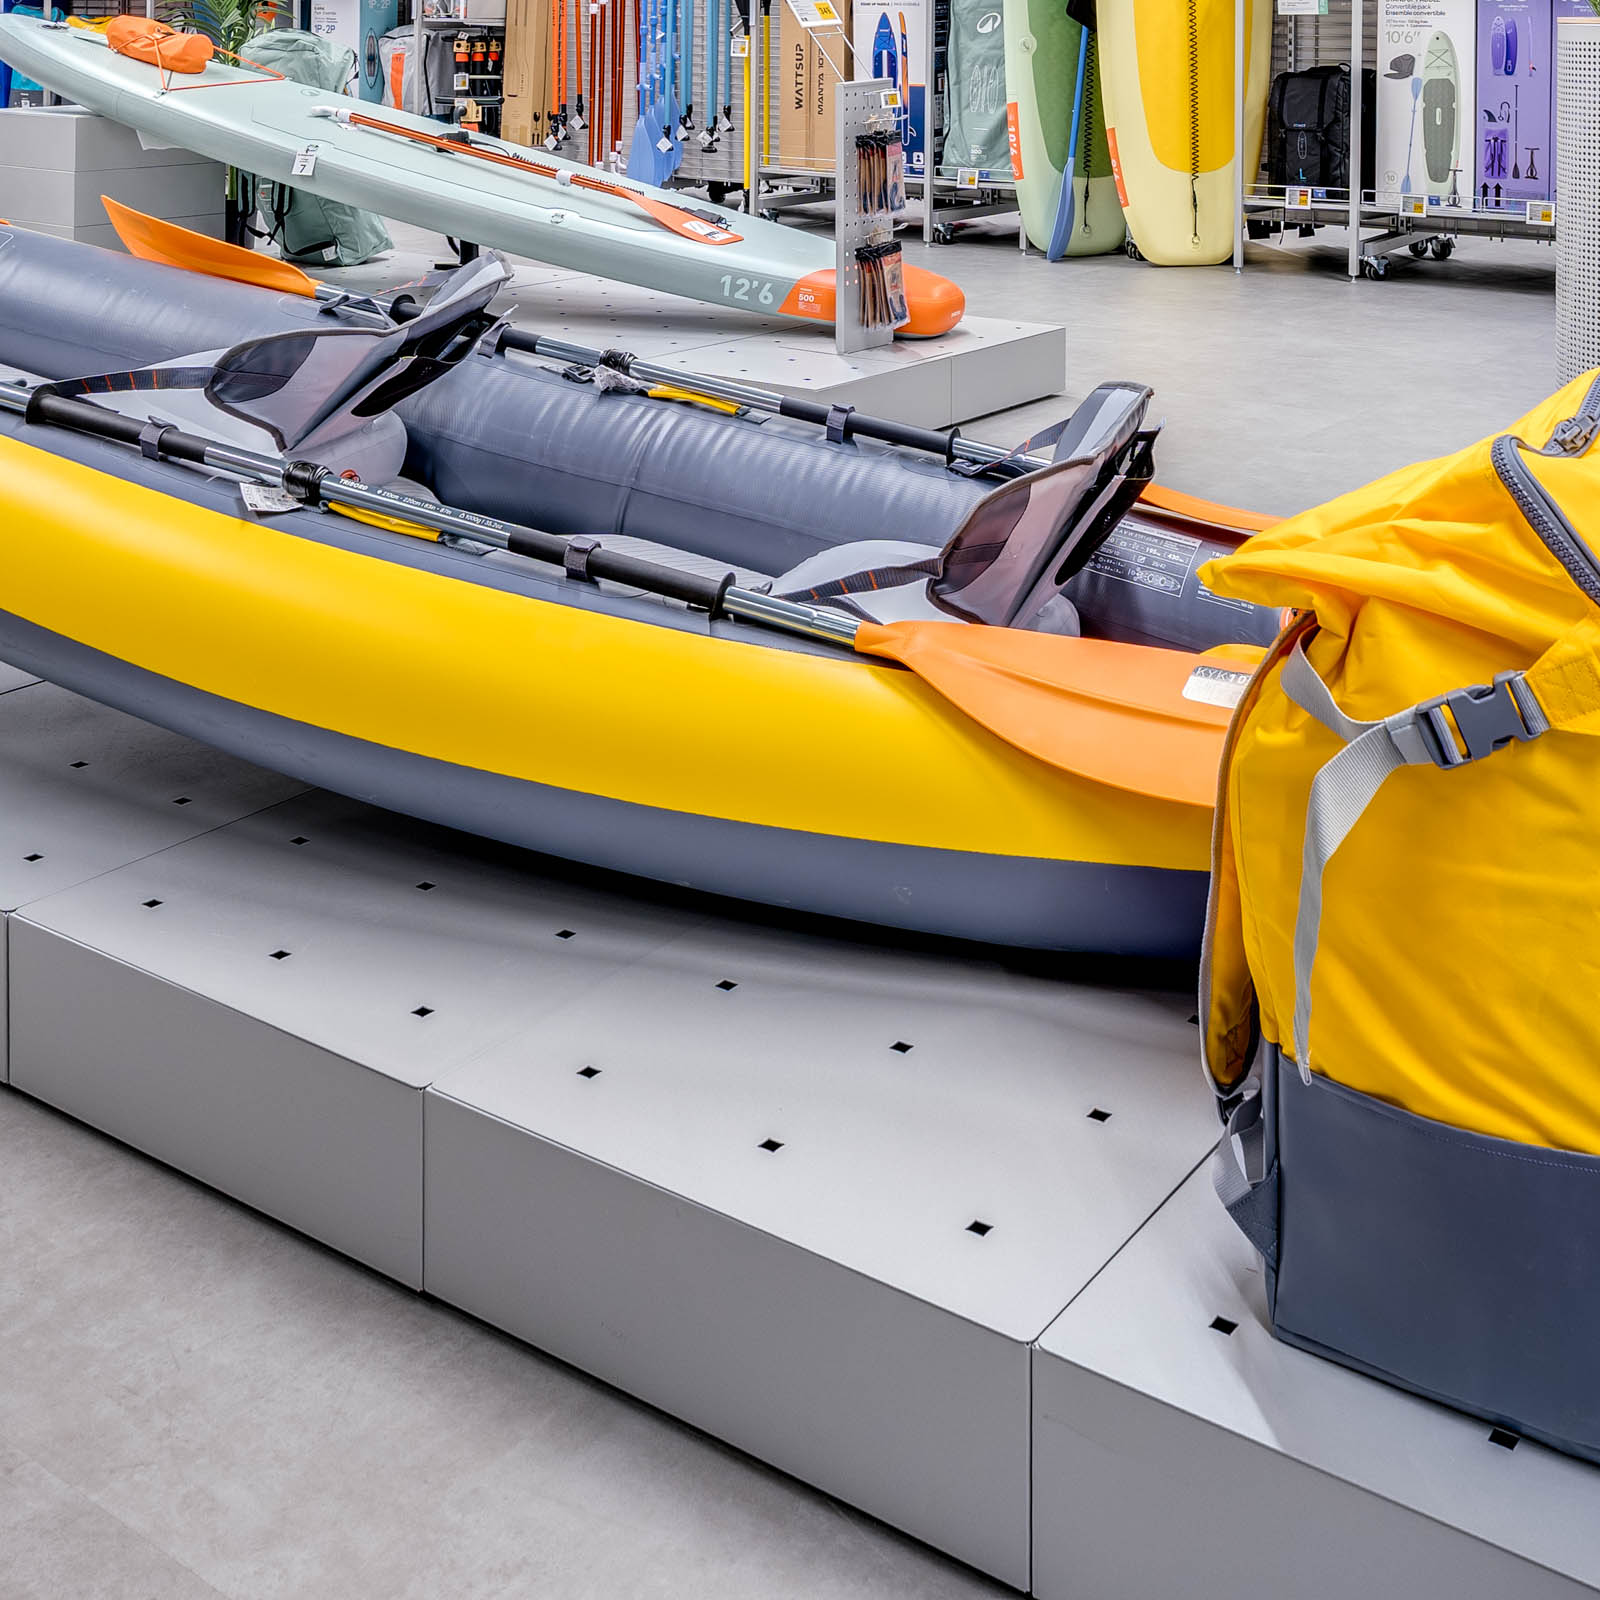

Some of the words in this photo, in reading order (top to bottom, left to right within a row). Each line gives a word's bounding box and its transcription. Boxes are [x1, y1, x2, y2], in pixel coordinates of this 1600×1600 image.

[794, 43, 804, 110] WATTSUP
[299, 164, 307, 173] 7
[719, 274, 774, 305] 12'6
[799, 293, 815, 303] 500
[339, 478, 369, 491] TRIBORD
[1196, 666, 1250, 685] KYK10
